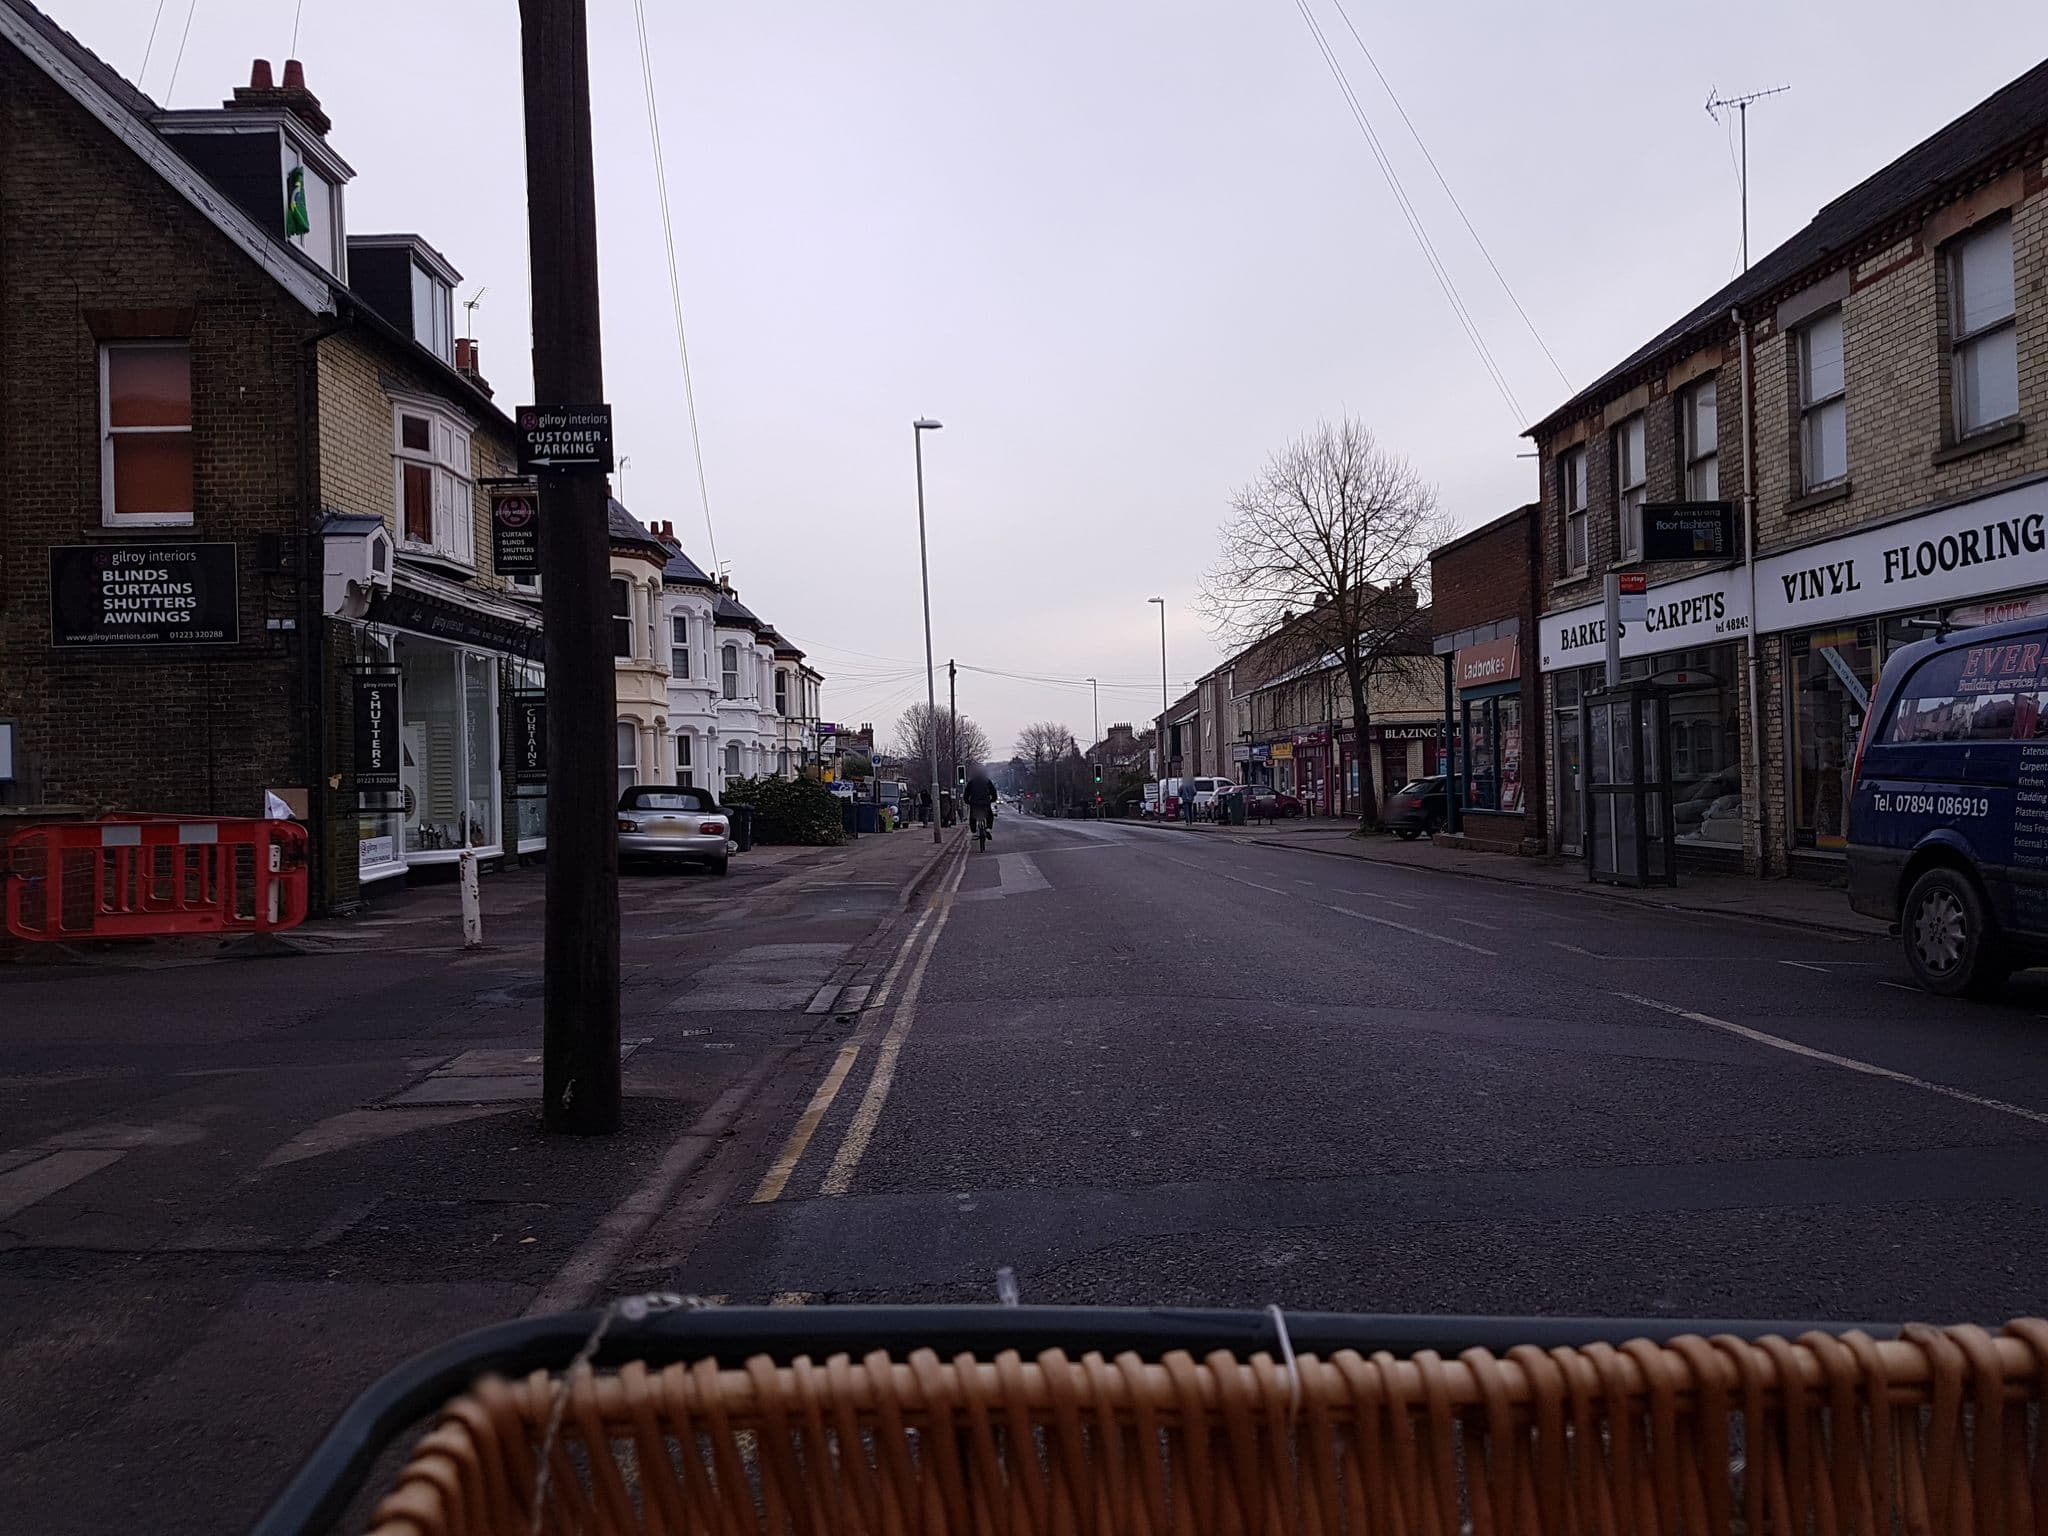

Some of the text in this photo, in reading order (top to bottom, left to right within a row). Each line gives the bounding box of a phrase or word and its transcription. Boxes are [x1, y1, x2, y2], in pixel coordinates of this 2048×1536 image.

[539, 413, 608, 428] gilroy interiors
[527, 431, 601, 443] CUSTOMER
[534, 443, 595, 455] PARKING
[1656, 519, 1714, 531] floor fashion
[112, 550, 197, 565] gilroy interiors
[1781, 514, 2046, 603] VINYL FLOORING
[103, 569, 169, 582] BLINDS
[103, 583, 193, 595] CURTAINS
[103, 597, 197, 609] SHUTTERS
[103, 611, 191, 624] AWNINGS
[1561, 592, 1725, 650] BARKES CARPETS
[66, 630, 224, 642] www.gilroyinteriors.com 01223 320288
[1464, 656, 1505, 680] Ladbrokes
[1957, 678, 1997, 693] Building
[370, 690, 381, 768] SHUTTERS
[1384, 727, 1437, 739] BLAZING
[527, 708, 537, 767] CURTAINS
[2017, 792, 2048, 805] Cladding
[1873, 794, 1988, 817] Tel. 07894 086919
